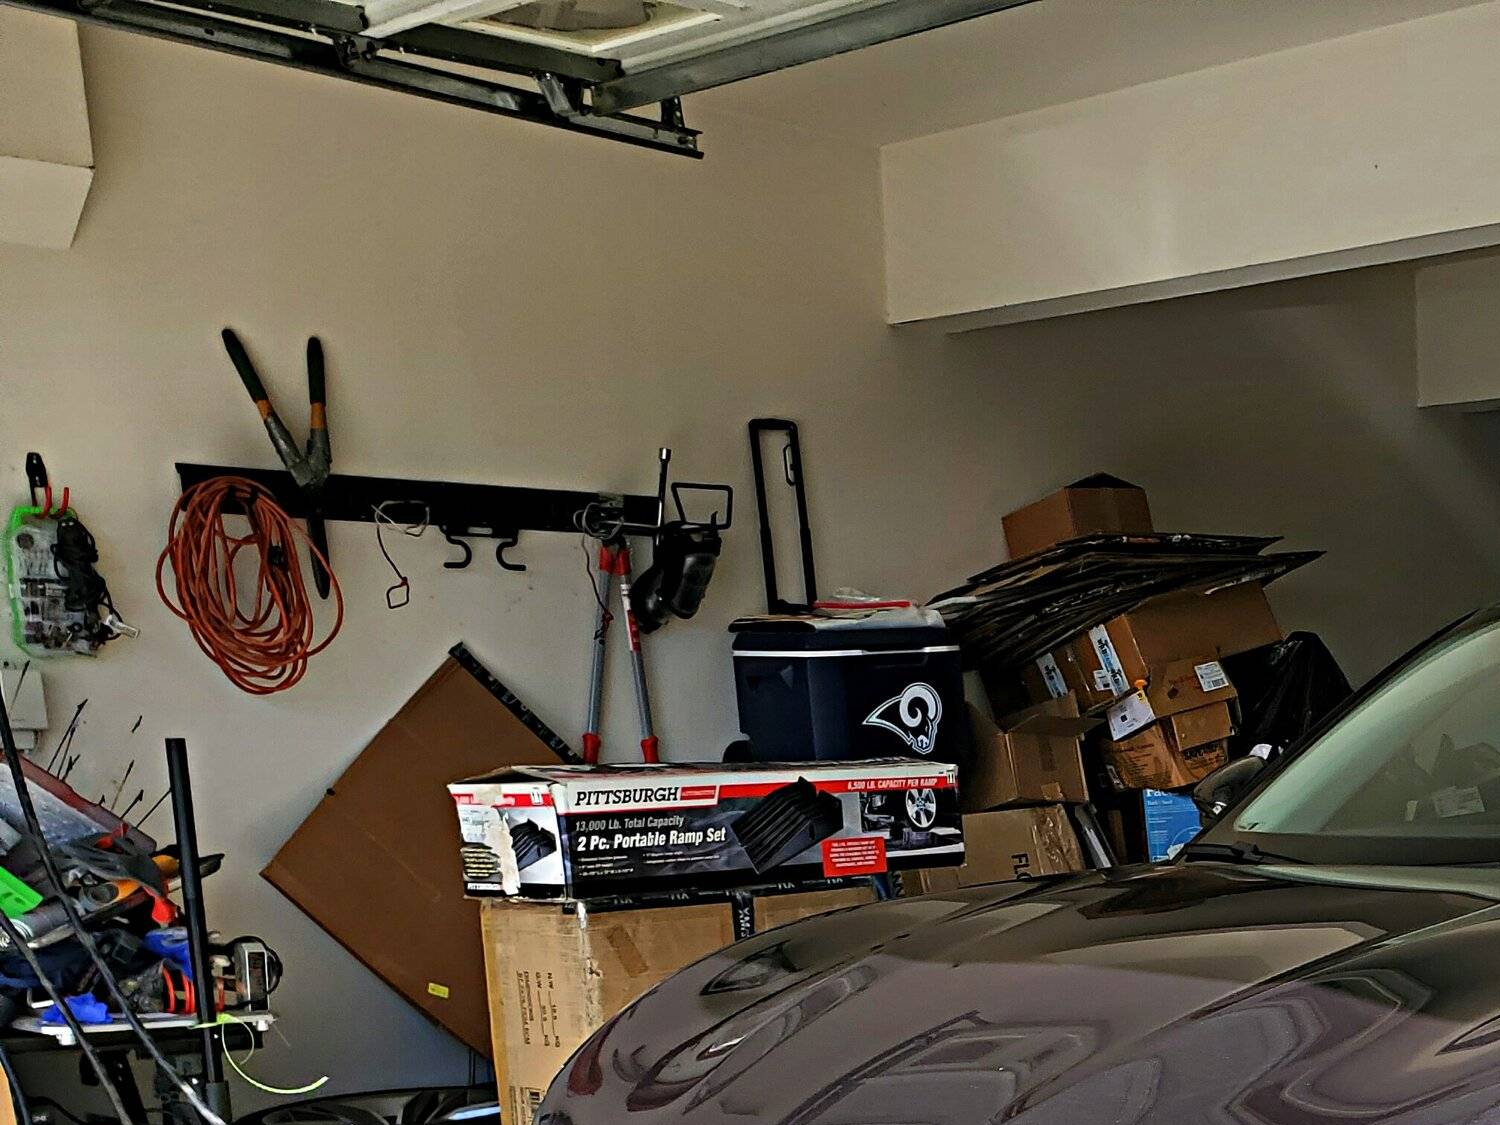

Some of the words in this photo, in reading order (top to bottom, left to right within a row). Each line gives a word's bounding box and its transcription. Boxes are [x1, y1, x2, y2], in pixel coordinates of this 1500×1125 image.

[878, 779, 906, 788] CAPACITY
[907, 778, 918, 787] PER
[920, 778, 938, 787] RAMP
[575, 787, 680, 806] PITTSBURGH
[575, 820, 606, 832] 13,000
[608, 819, 621, 830] Lb.
[624, 817, 646, 828] Total
[647, 815, 684, 829] Capacity
[577, 836, 586, 851] 2
[590, 835, 610, 850] Pc.
[613, 831, 666, 849] Portable
[669, 830, 703, 846] Ramp
[706, 827, 726, 842] Set
